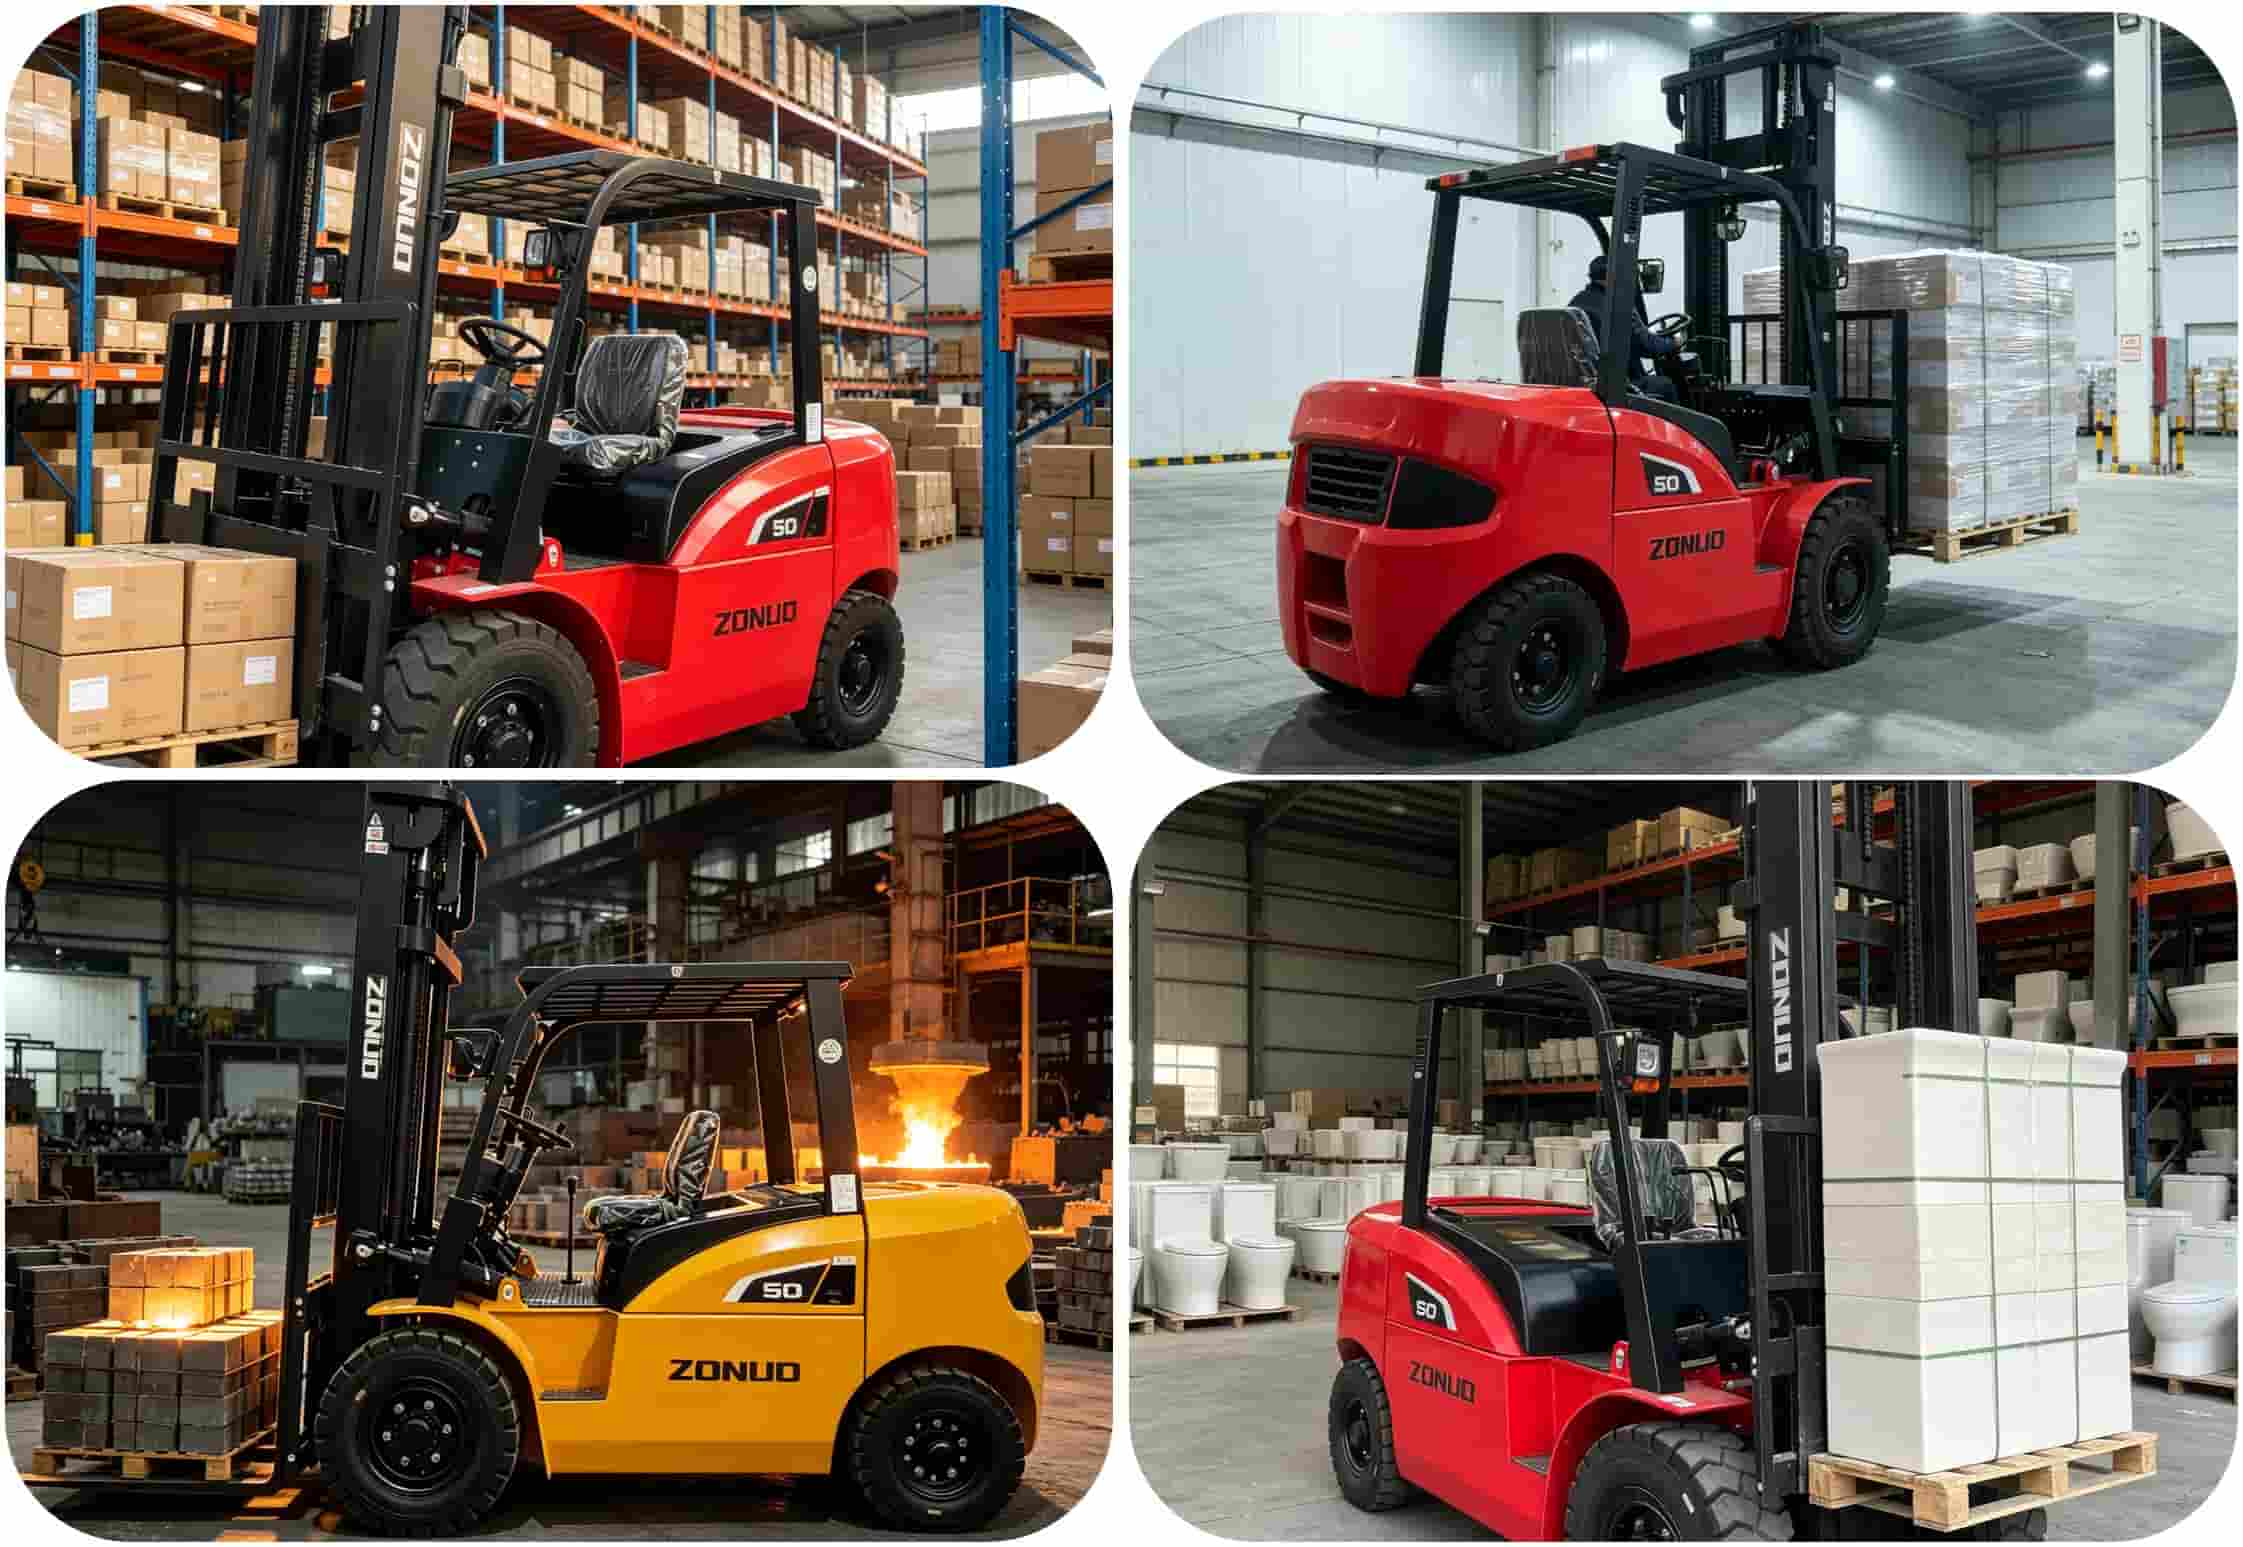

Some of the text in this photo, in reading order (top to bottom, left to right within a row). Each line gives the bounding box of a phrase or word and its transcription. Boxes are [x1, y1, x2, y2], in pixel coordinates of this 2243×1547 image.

[1653, 475, 1680, 493] 50
[772, 518, 798, 537] 50
[762, 1282, 803, 1299] 50
[1415, 1300, 1437, 1320] 50
